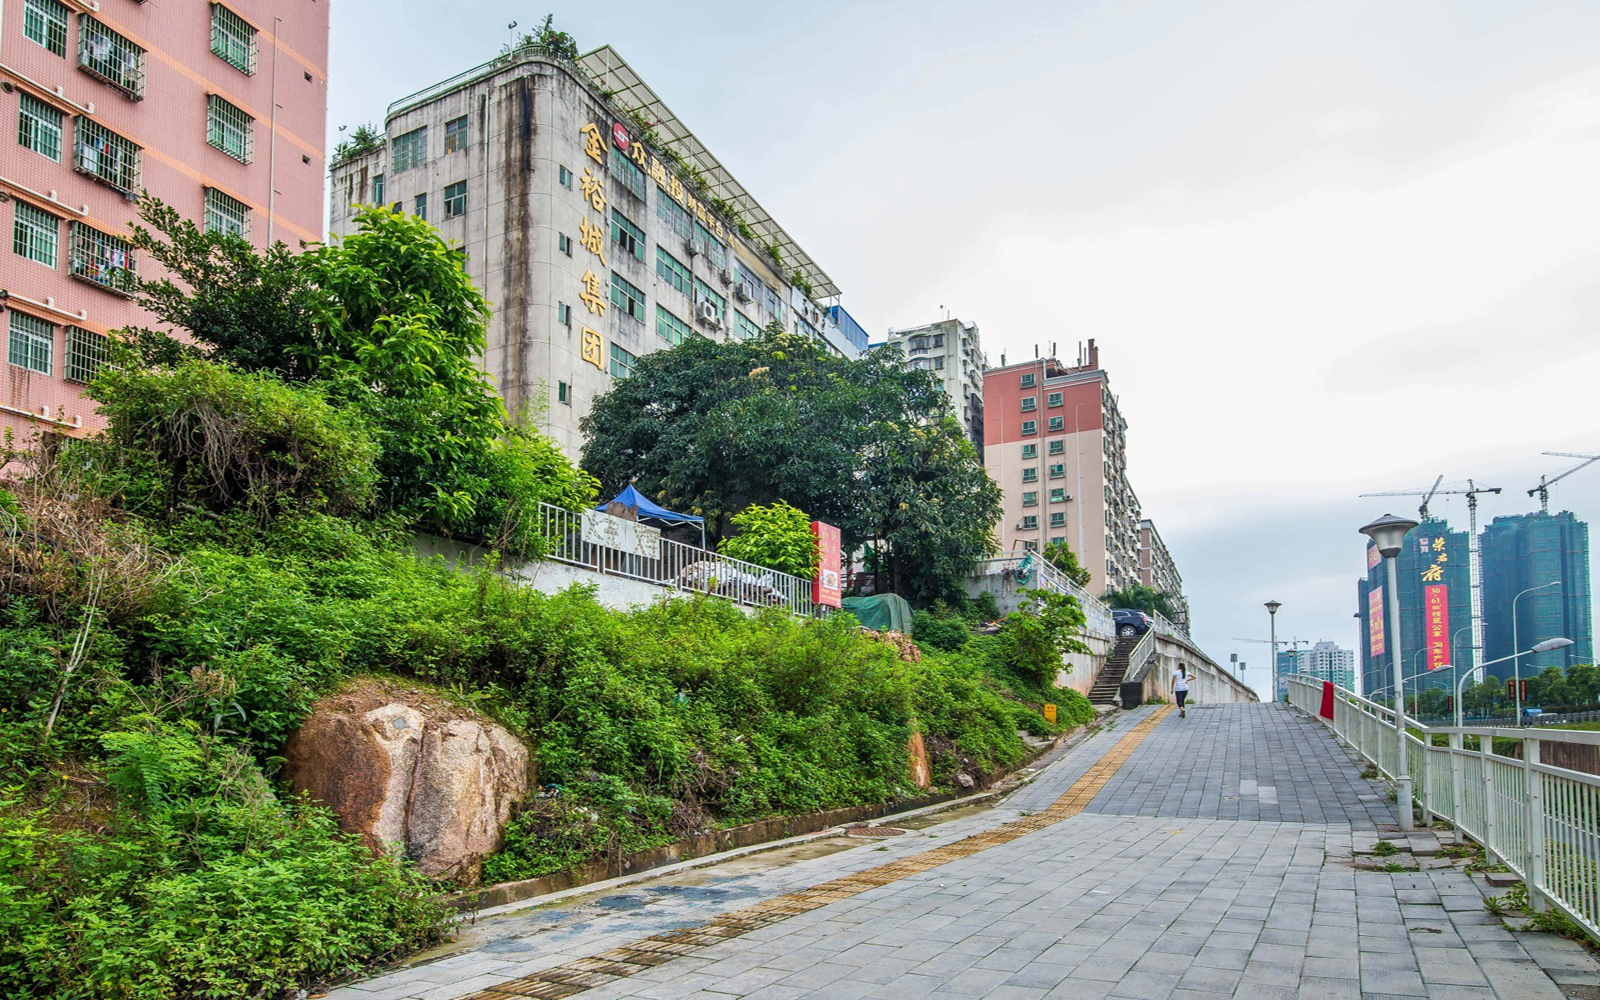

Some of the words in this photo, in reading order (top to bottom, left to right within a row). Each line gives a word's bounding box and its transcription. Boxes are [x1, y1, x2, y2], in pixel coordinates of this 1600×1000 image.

[579, 122, 607, 370] 金裕城集团
